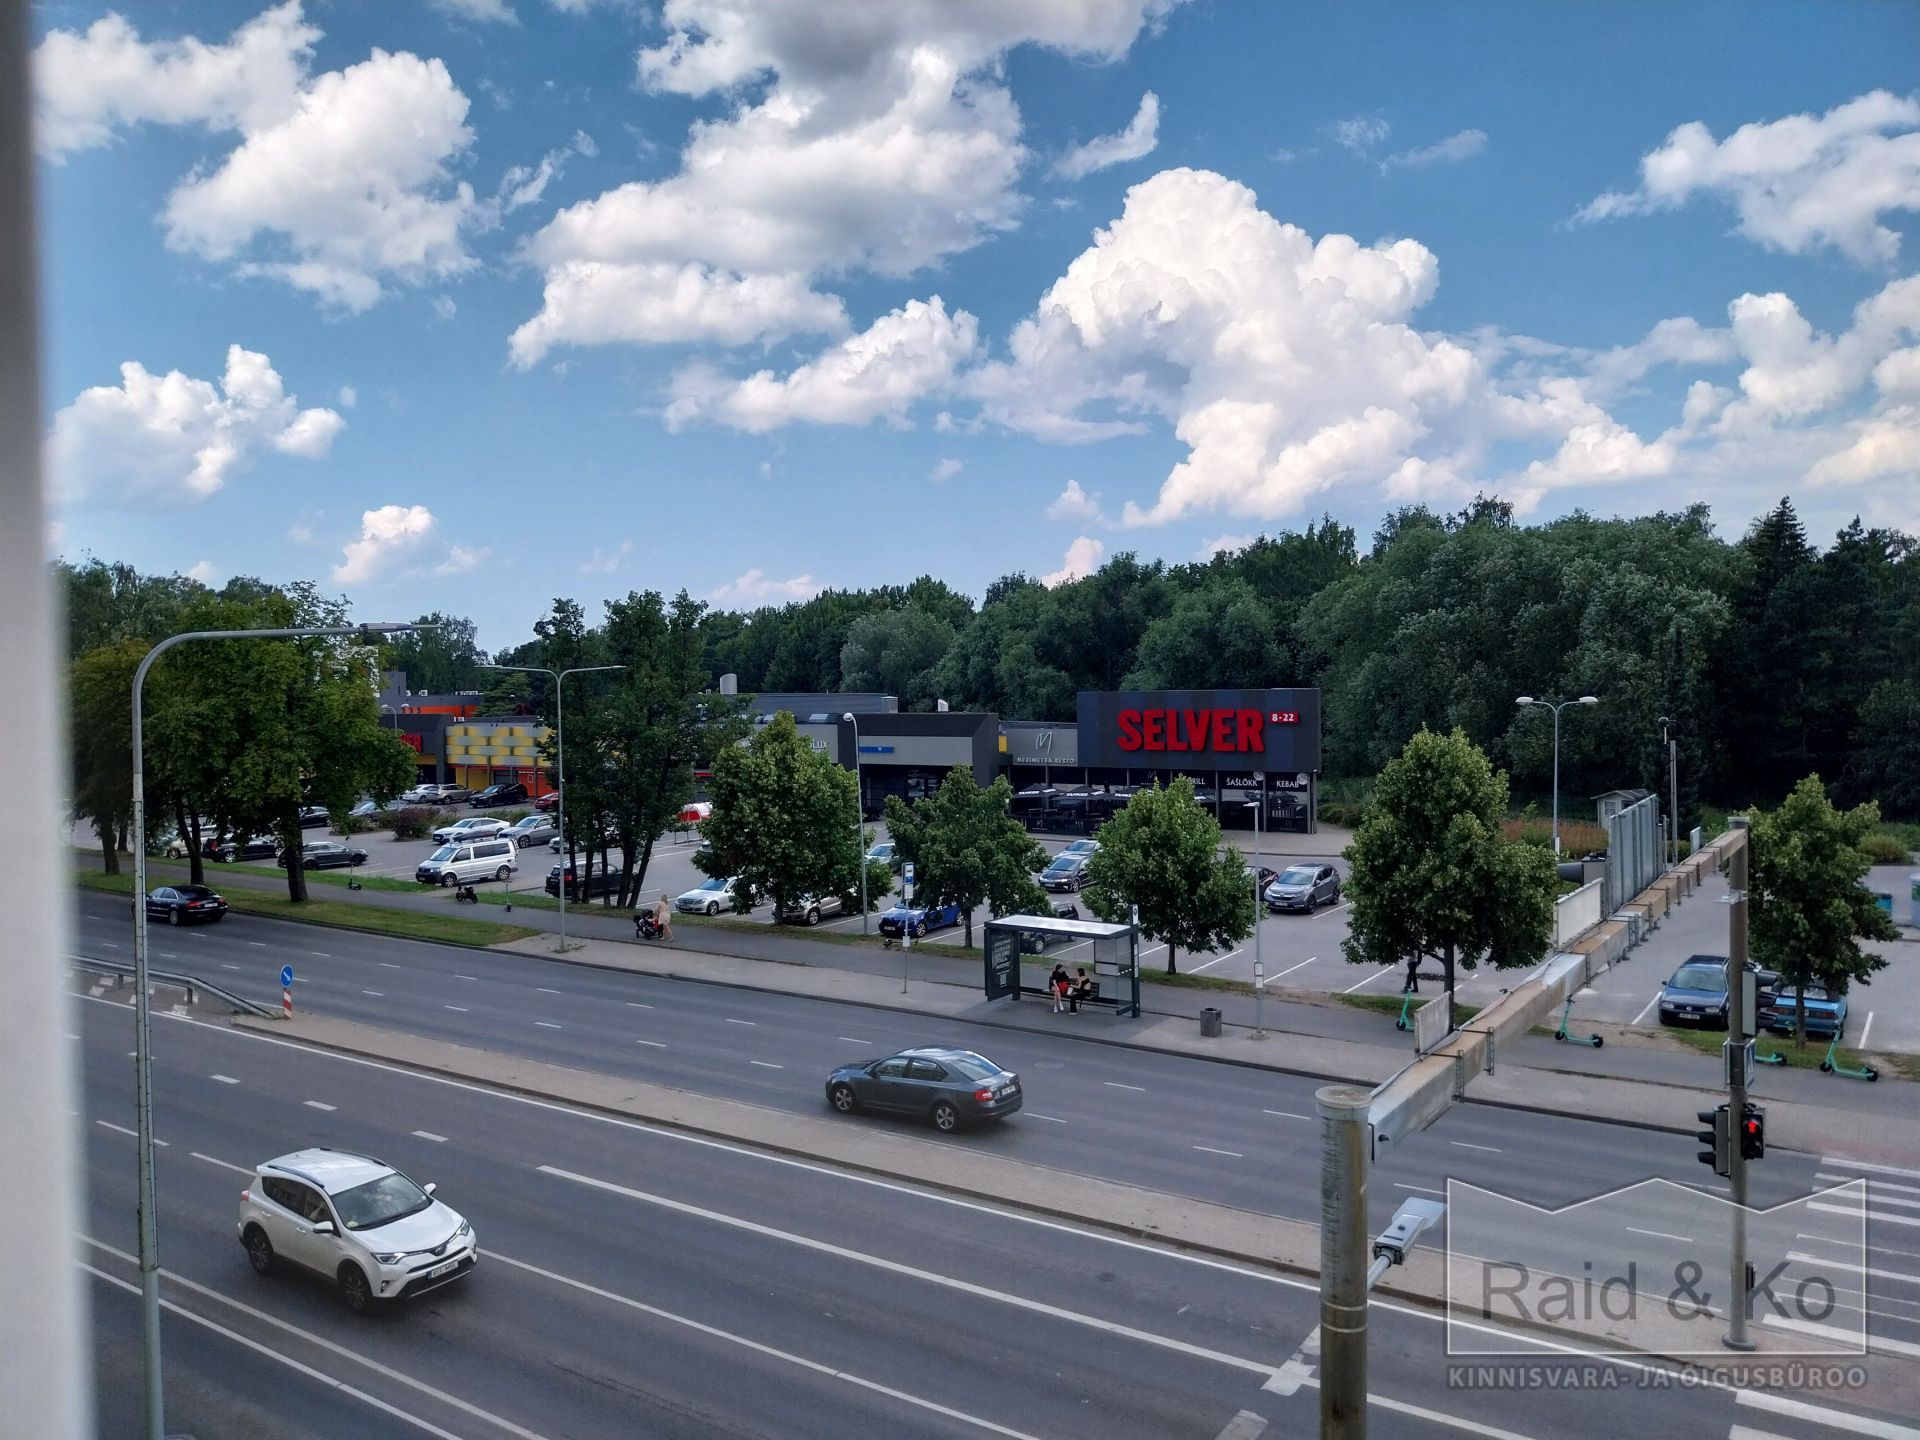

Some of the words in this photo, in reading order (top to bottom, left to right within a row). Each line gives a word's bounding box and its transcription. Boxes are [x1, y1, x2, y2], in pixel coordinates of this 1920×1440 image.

[1271, 713, 1294, 722] 8-22
[1117, 709, 1265, 752] SELVER
[1276, 780, 1299, 788] KEBAB
